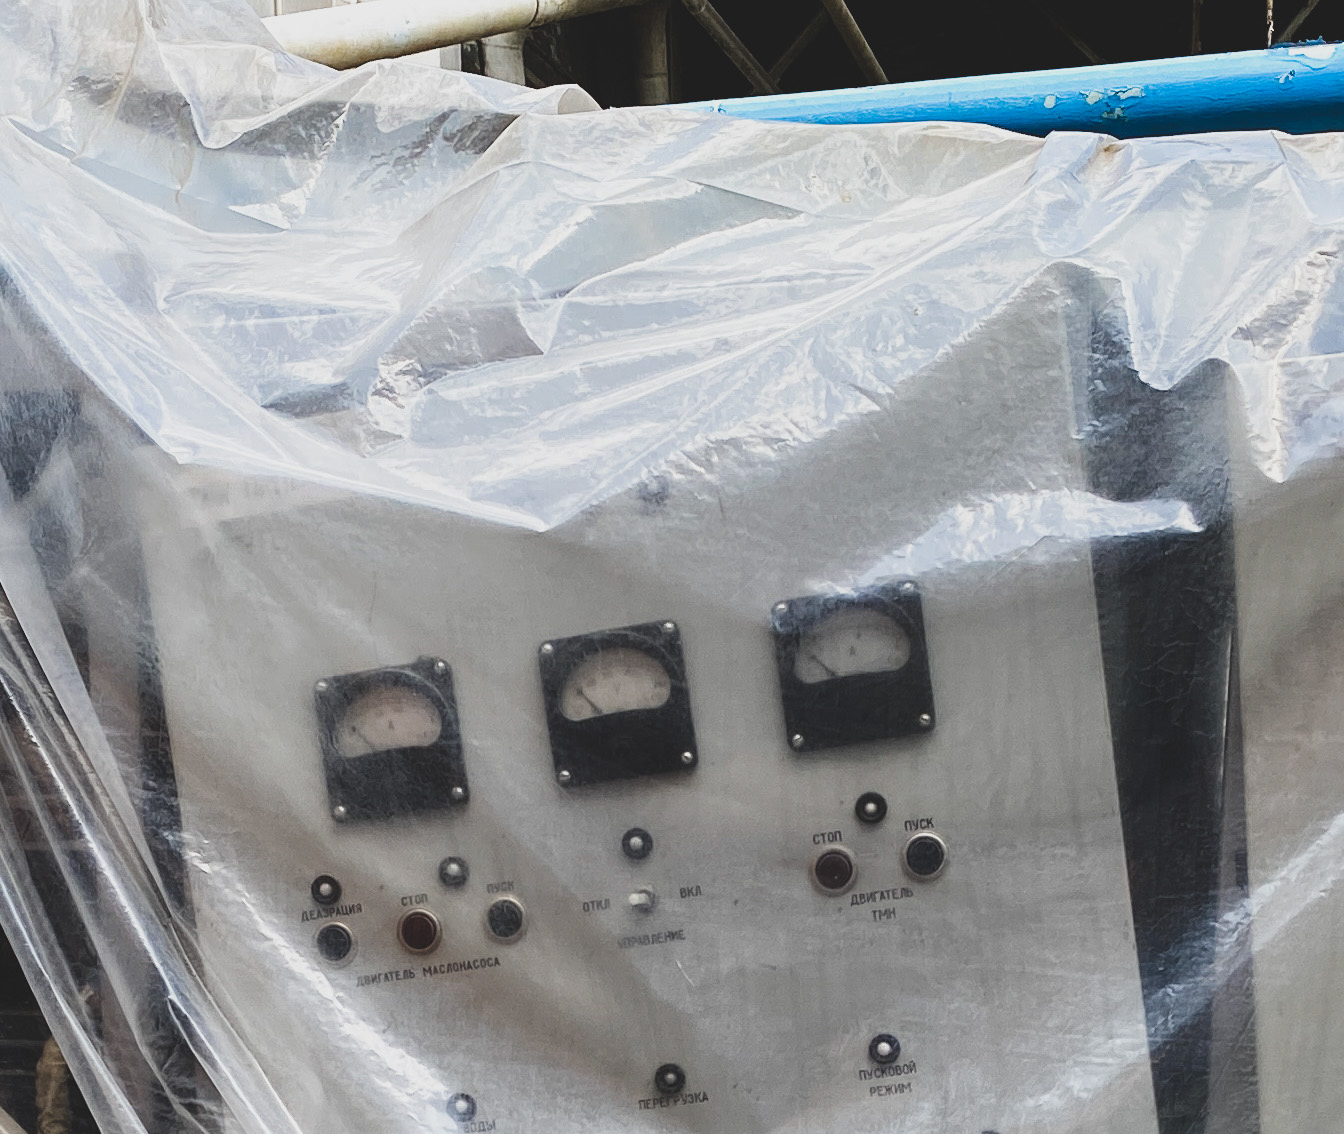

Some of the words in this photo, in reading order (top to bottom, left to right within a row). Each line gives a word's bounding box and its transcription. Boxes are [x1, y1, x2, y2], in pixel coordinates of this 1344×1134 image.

[904, 818, 934, 831] ПУСК
[812, 830, 842, 845] СТОП
[486, 881, 515, 894] ПУСК
[401, 893, 428, 906] СТОП
[850, 887, 914, 906] ДВИГАТЕЛЬ
[872, 908, 896, 922] ТМН
[356, 969, 416, 987] ДВИГАТЕЛЬ
[422, 957, 501, 977] МАСЛОНАСОСА
[858, 1060, 917, 1080] ПУСКОВОЙ
[869, 1082, 913, 1097] РЕЖИМ
